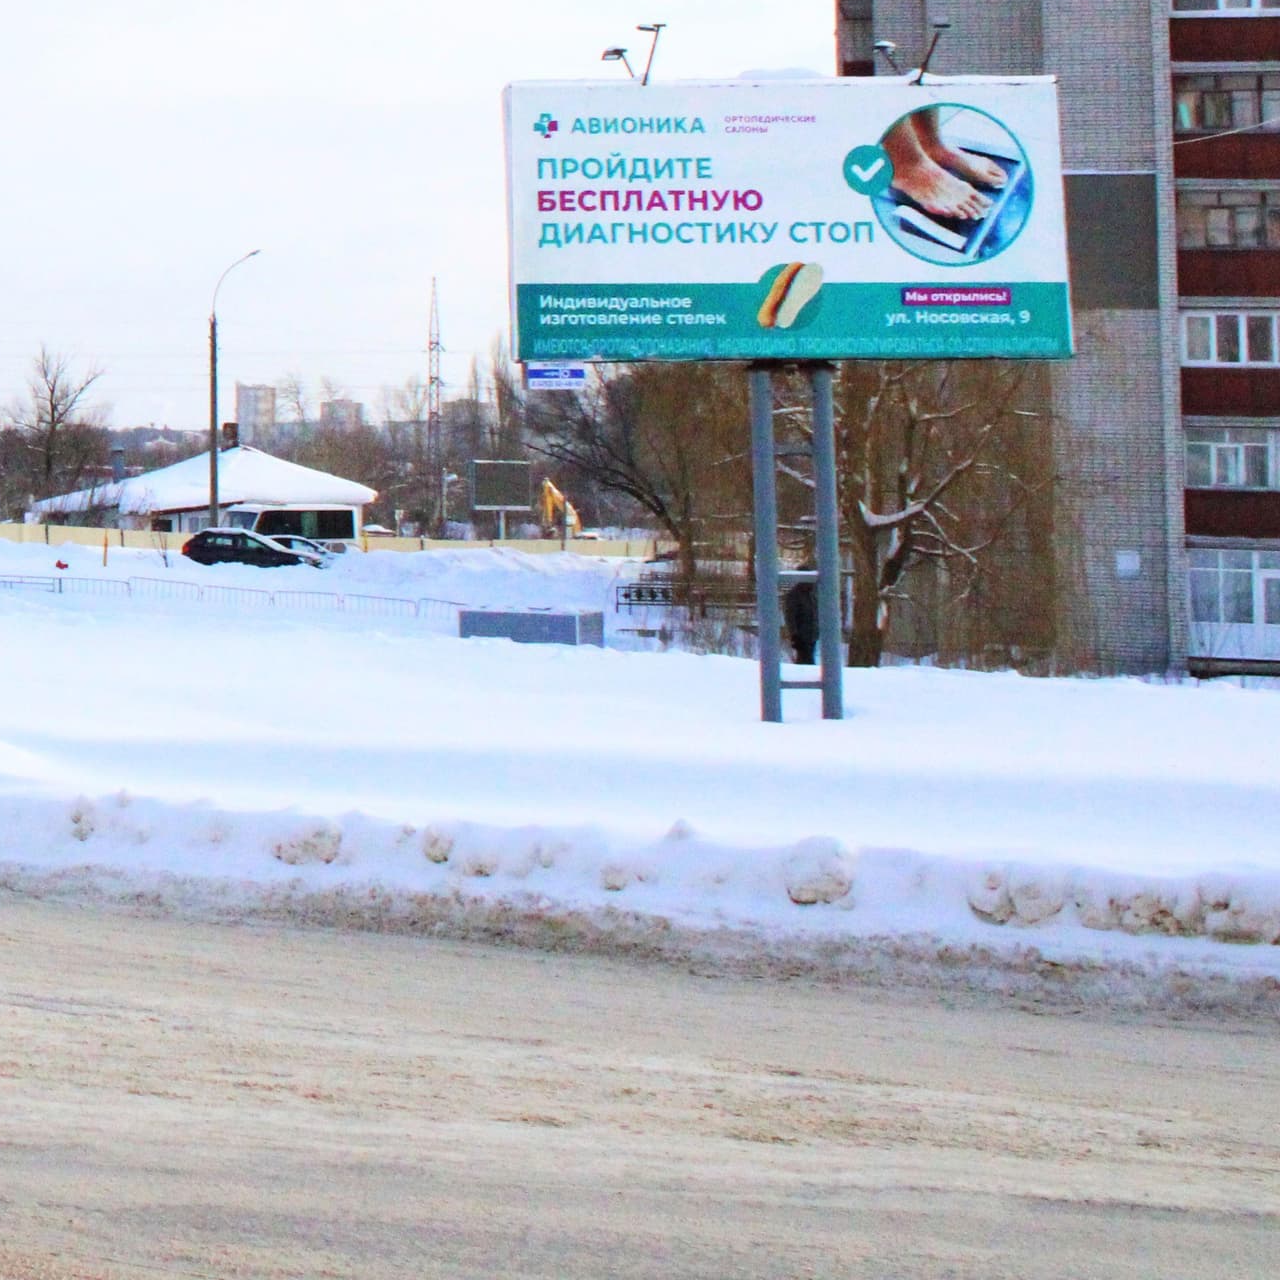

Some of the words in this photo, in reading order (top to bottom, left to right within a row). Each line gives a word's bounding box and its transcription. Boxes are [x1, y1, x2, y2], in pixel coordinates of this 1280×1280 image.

[570, 117, 706, 134] АВИОНИКА
[724, 115, 817, 124] ОРТОПЕДИЧЕСКИЕ
[536, 152, 713, 183] ПРОЙДИТЕ
[537, 190, 763, 212] БЕСПЛАТНУЮ
[538, 222, 778, 248] ДИАГНОСТИКУ
[789, 222, 875, 243] СТОП
[539, 294, 692, 311] Индивидуальное
[905, 291, 928, 301] Мы
[931, 291, 1007, 304] открылись!
[540, 313, 663, 325] изготовление
[667, 313, 727, 325] стелек
[885, 314, 911, 327] ул.
[915, 311, 1016, 326] Носовская,
[1019, 310, 1031, 324] 9
